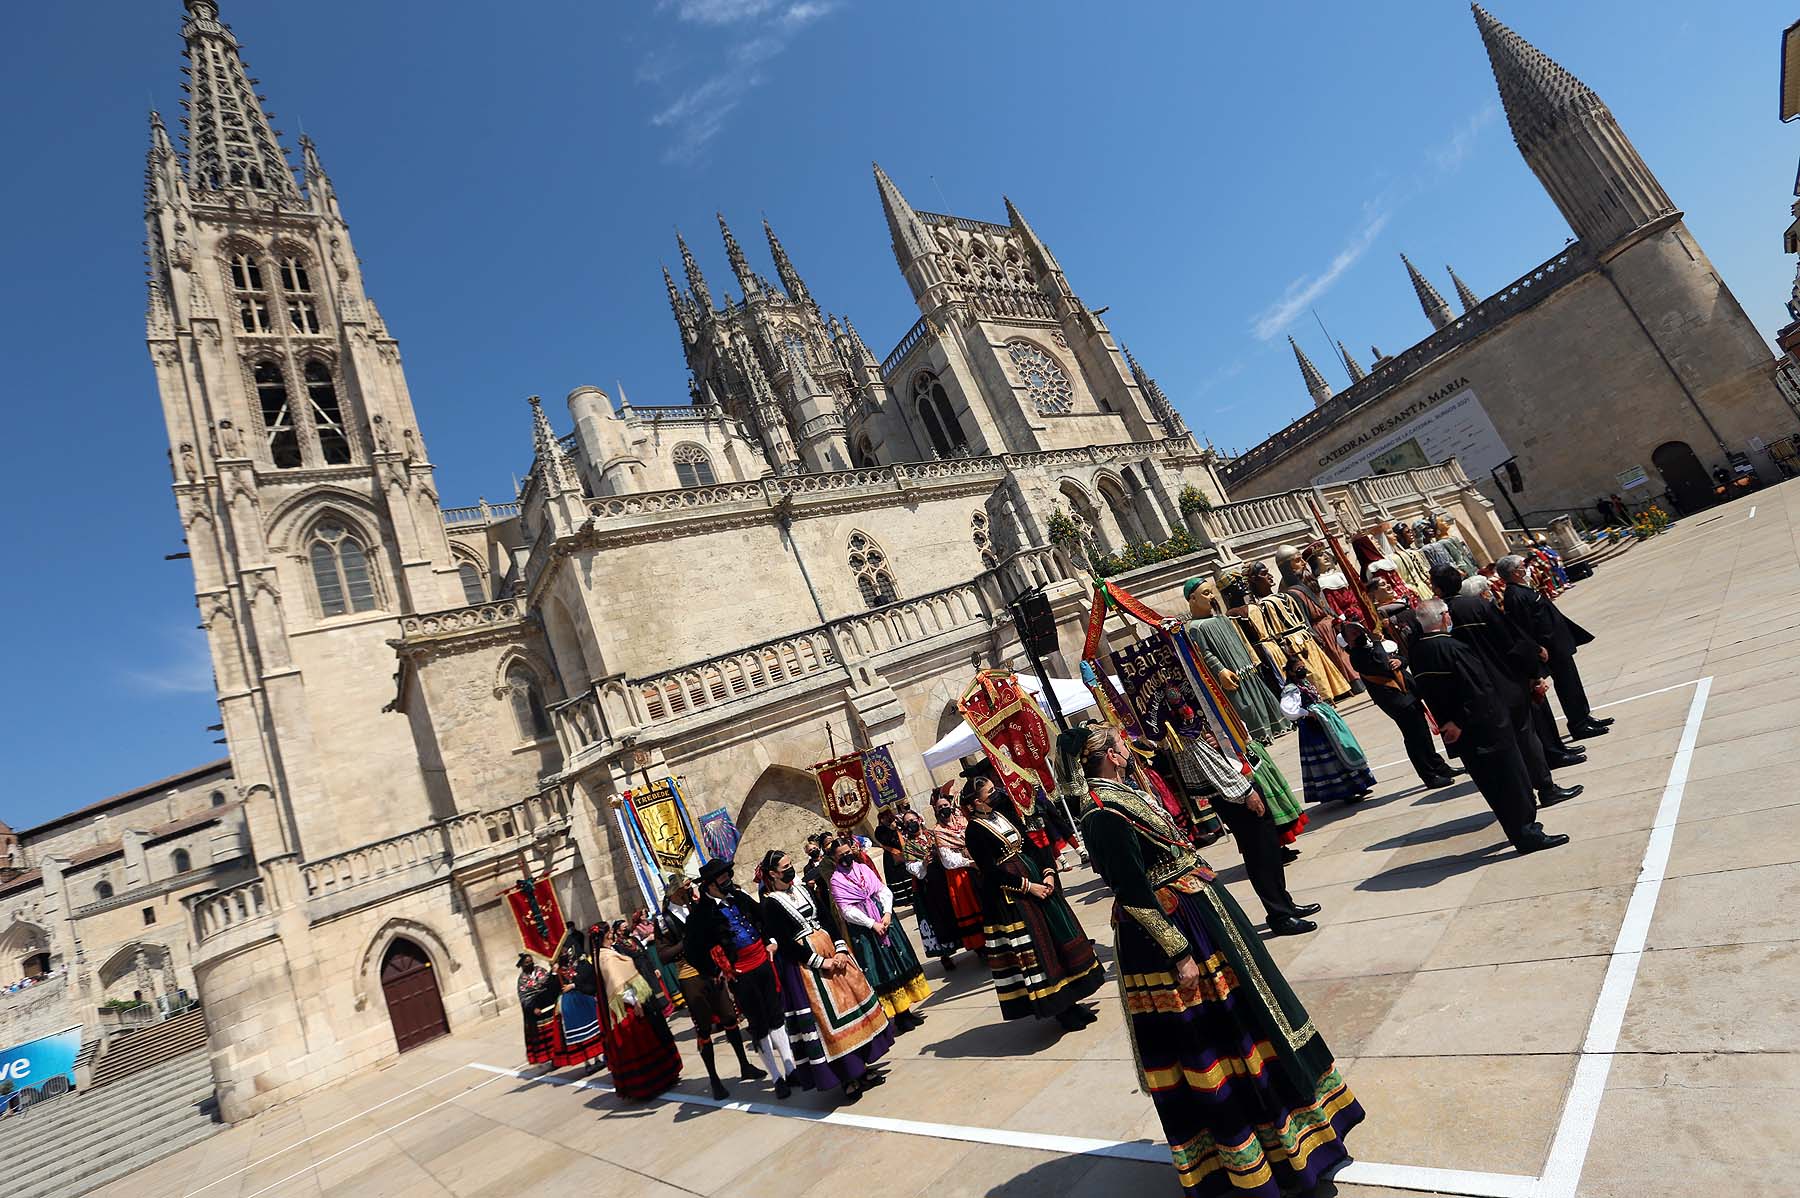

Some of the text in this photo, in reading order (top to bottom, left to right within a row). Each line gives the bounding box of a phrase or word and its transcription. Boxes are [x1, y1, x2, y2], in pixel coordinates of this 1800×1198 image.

[1318, 433, 1371, 467] CATEDRAL
[1371, 423, 1386, 437] DE
[1386, 401, 1428, 428] SANTA
[637, 790, 670, 805] TREBEDE
